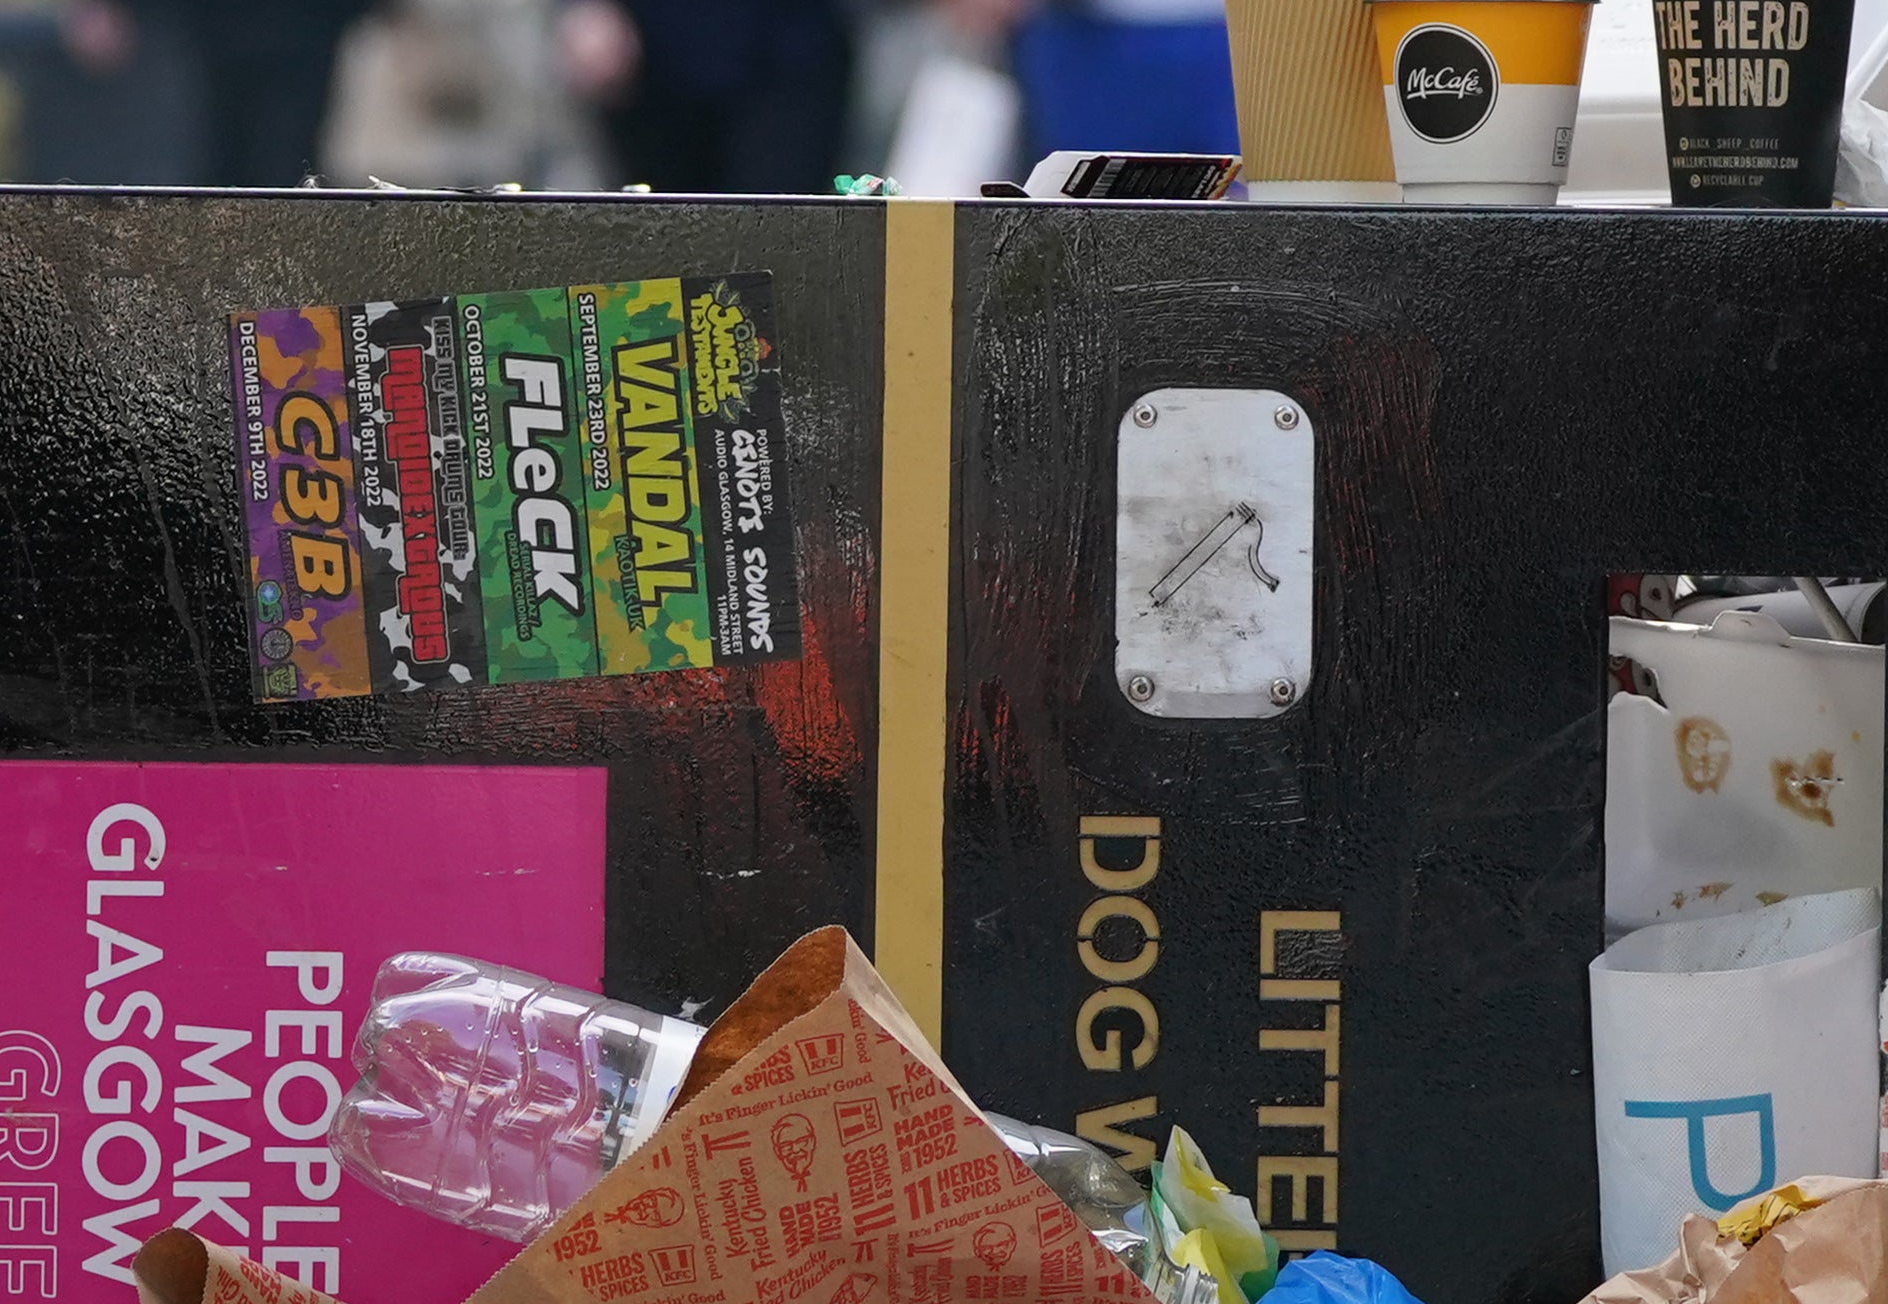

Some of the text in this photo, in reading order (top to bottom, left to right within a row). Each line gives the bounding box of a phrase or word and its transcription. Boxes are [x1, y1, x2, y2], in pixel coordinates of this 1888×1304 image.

[1656, 0, 1809, 51] THE HERD
[1407, 67, 1480, 99] McCafé
[1668, 58, 1790, 107] BEHIND
[1748, 175, 1764, 186] CUP
[691, 293, 717, 414] TESTAMENTS
[715, 304, 744, 400] JUNGLE
[239, 322, 268, 500] DECEMBER 9TH 2022
[352, 315, 381, 506] NOVEMBER 18TH 2022
[464, 306, 492, 479] OCTOBER 21ST 2022
[579, 294, 609, 489] SEPTEMBER 23RD 2022
[618, 341, 692, 603] VANDAL
[757, 429, 773, 515] POWERED BY:
[507, 533, 519, 568] DREAD
[521, 543, 534, 581] SERIAL
[715, 429, 743, 654] AUDIO GLASGOW, 14 MIDLAND STREET
[627, 604, 644, 629] UK
[744, 548, 772, 652] SOUNDS
[717, 595, 730, 655] 11PM-3AM
[1075, 816, 1161, 1071] DOG
[81, 801, 167, 1288] GLASGOW
[811, 1057, 839, 1070] KFC
[855, 1032, 871, 1064] Good
[698, 1073, 873, 1126] It's Finger Lickin' Good
[745, 1065, 795, 1092] SPICES
[887, 1080, 936, 1112] Fried
[265, 949, 343, 1296] PEOPLE
[864, 1100, 879, 1131] KFC
[894, 1104, 954, 1135] HAND
[896, 1118, 956, 1152] MADE
[172, 1023, 253, 1262] MAK
[871, 1144, 891, 1186] SPICES
[913, 1132, 958, 1169] 1952
[845, 1148, 875, 1209] HERBS
[903, 1154, 999, 1221] 11 HERBS
[948, 1178, 1001, 1204] SPICES
[715, 1177, 749, 1259] Kentucky
[739, 1156, 776, 1273] Fried Chicken
[779, 1205, 800, 1259] HAND
[794, 1199, 815, 1254] MADE
[814, 1192, 842, 1229] 1952
[933, 1192, 1035, 1234] Finger Lickin'
[555, 1230, 602, 1262] 1952
[580, 1252, 646, 1289] HERBS
[599, 1275, 650, 1302] SPICES
[664, 1271, 692, 1283] KFC
[756, 1250, 827, 1298] Kentucky
[787, 1257, 846, 1300] Chicken
[688, 1290, 726, 1304] Good
